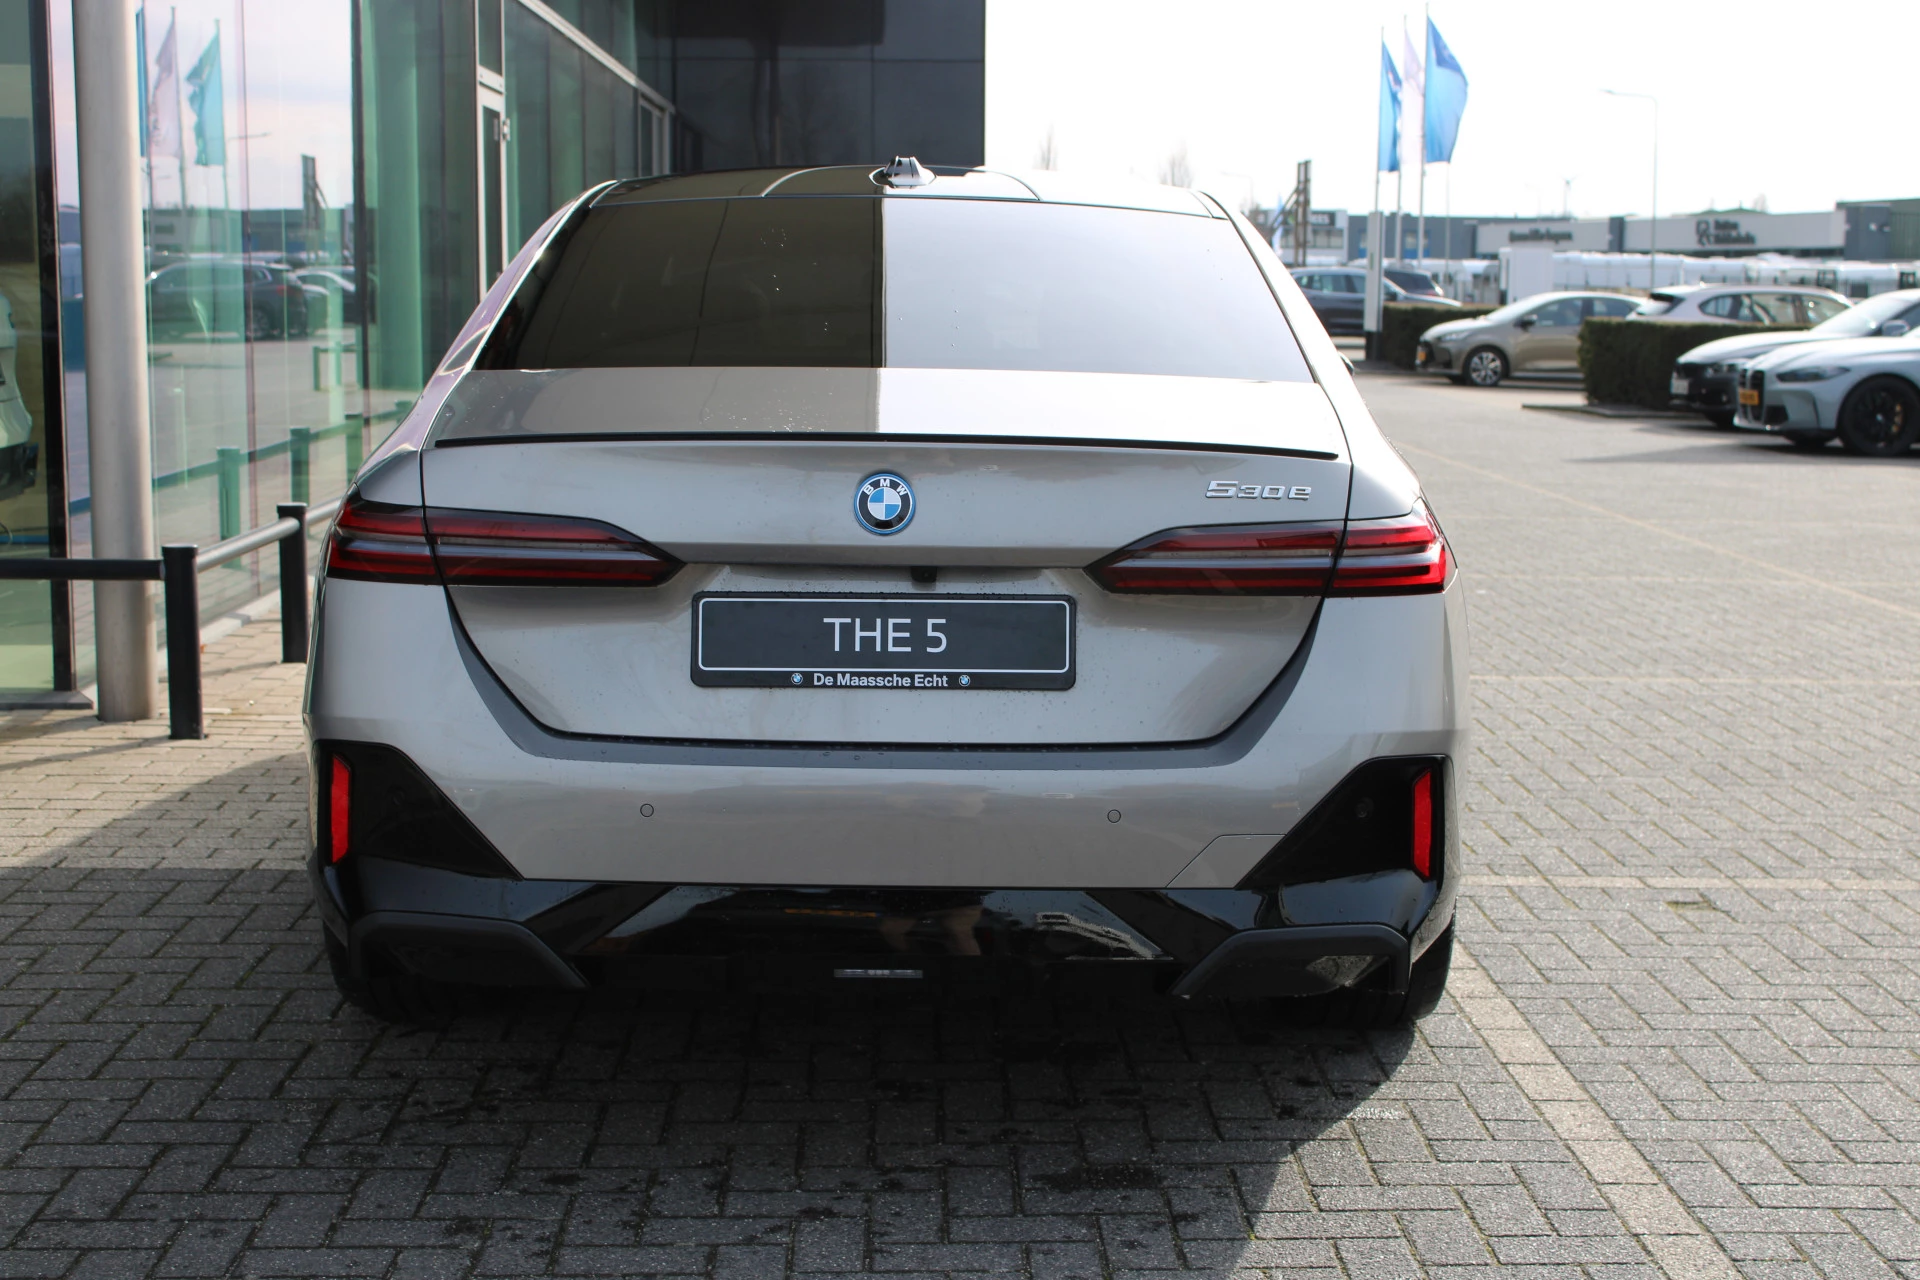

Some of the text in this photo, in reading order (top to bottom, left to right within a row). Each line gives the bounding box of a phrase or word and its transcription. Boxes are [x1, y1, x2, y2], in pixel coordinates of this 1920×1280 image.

[863, 479, 908, 495] BMW
[823, 618, 947, 653] THE 5
[813, 673, 834, 686] De
[837, 673, 911, 686] Maassche
[914, 674, 948, 687] Echt
